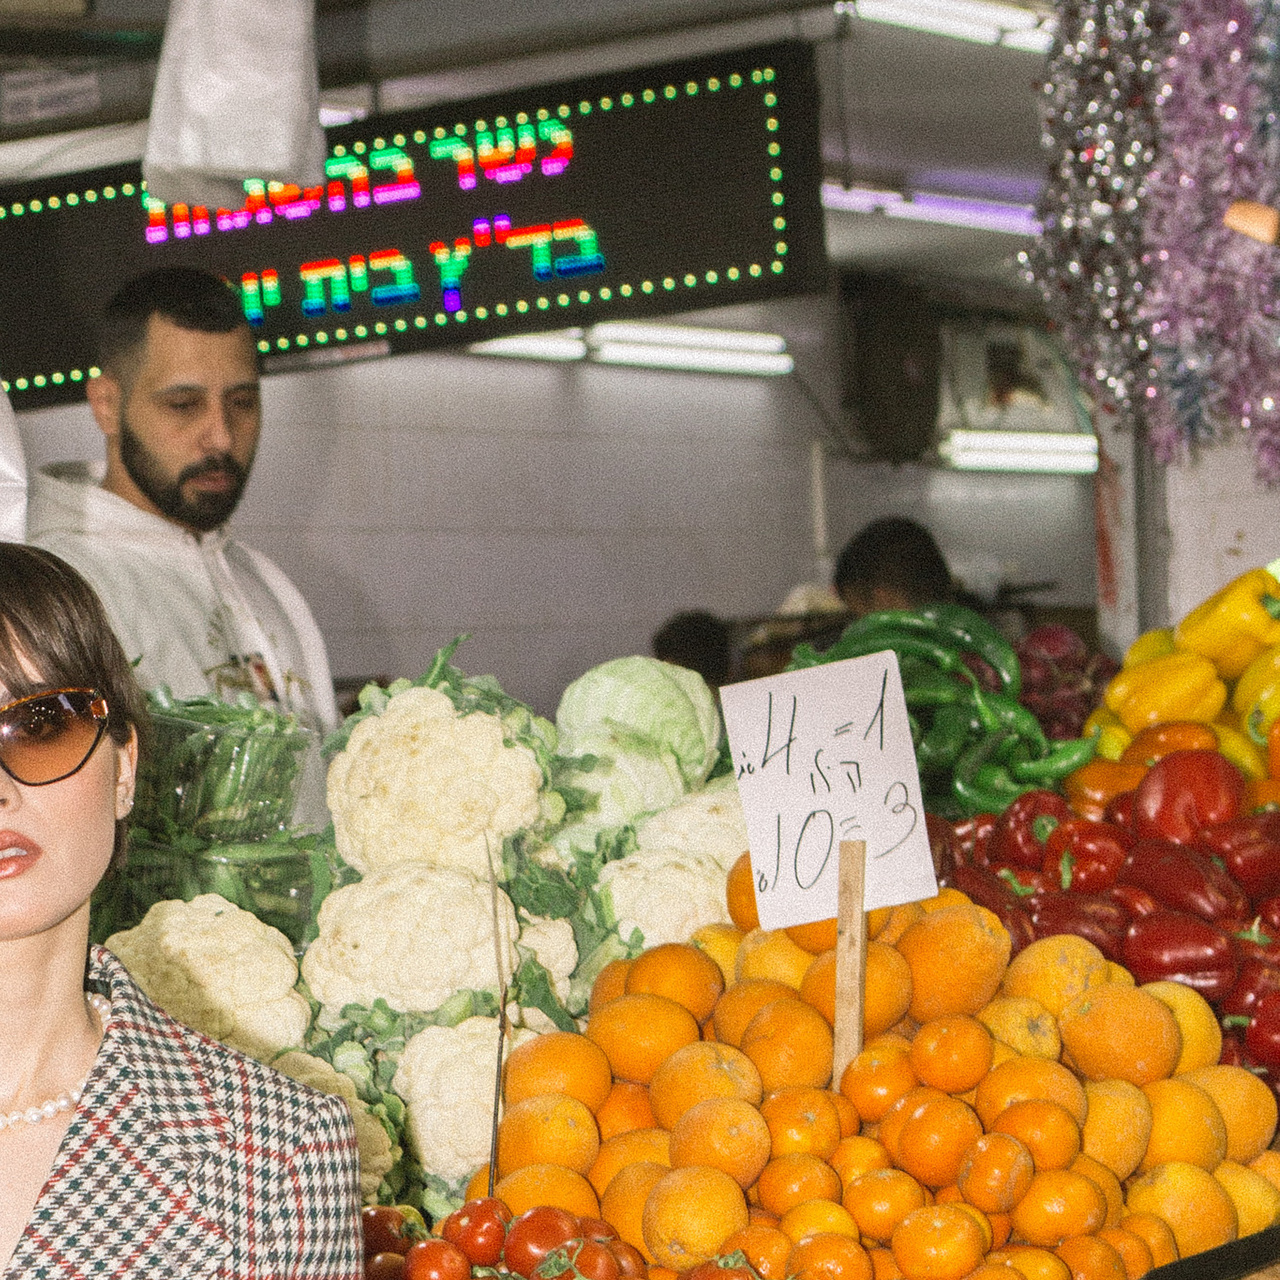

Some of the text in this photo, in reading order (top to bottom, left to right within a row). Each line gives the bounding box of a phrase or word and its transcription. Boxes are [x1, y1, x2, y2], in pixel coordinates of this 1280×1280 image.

[429, 117, 574, 190] כשר
[300, 248, 420, 318] בית
[761, 691, 797, 775] 4
[771, 809, 834, 891] 10
[874, 781, 918, 860] 3
